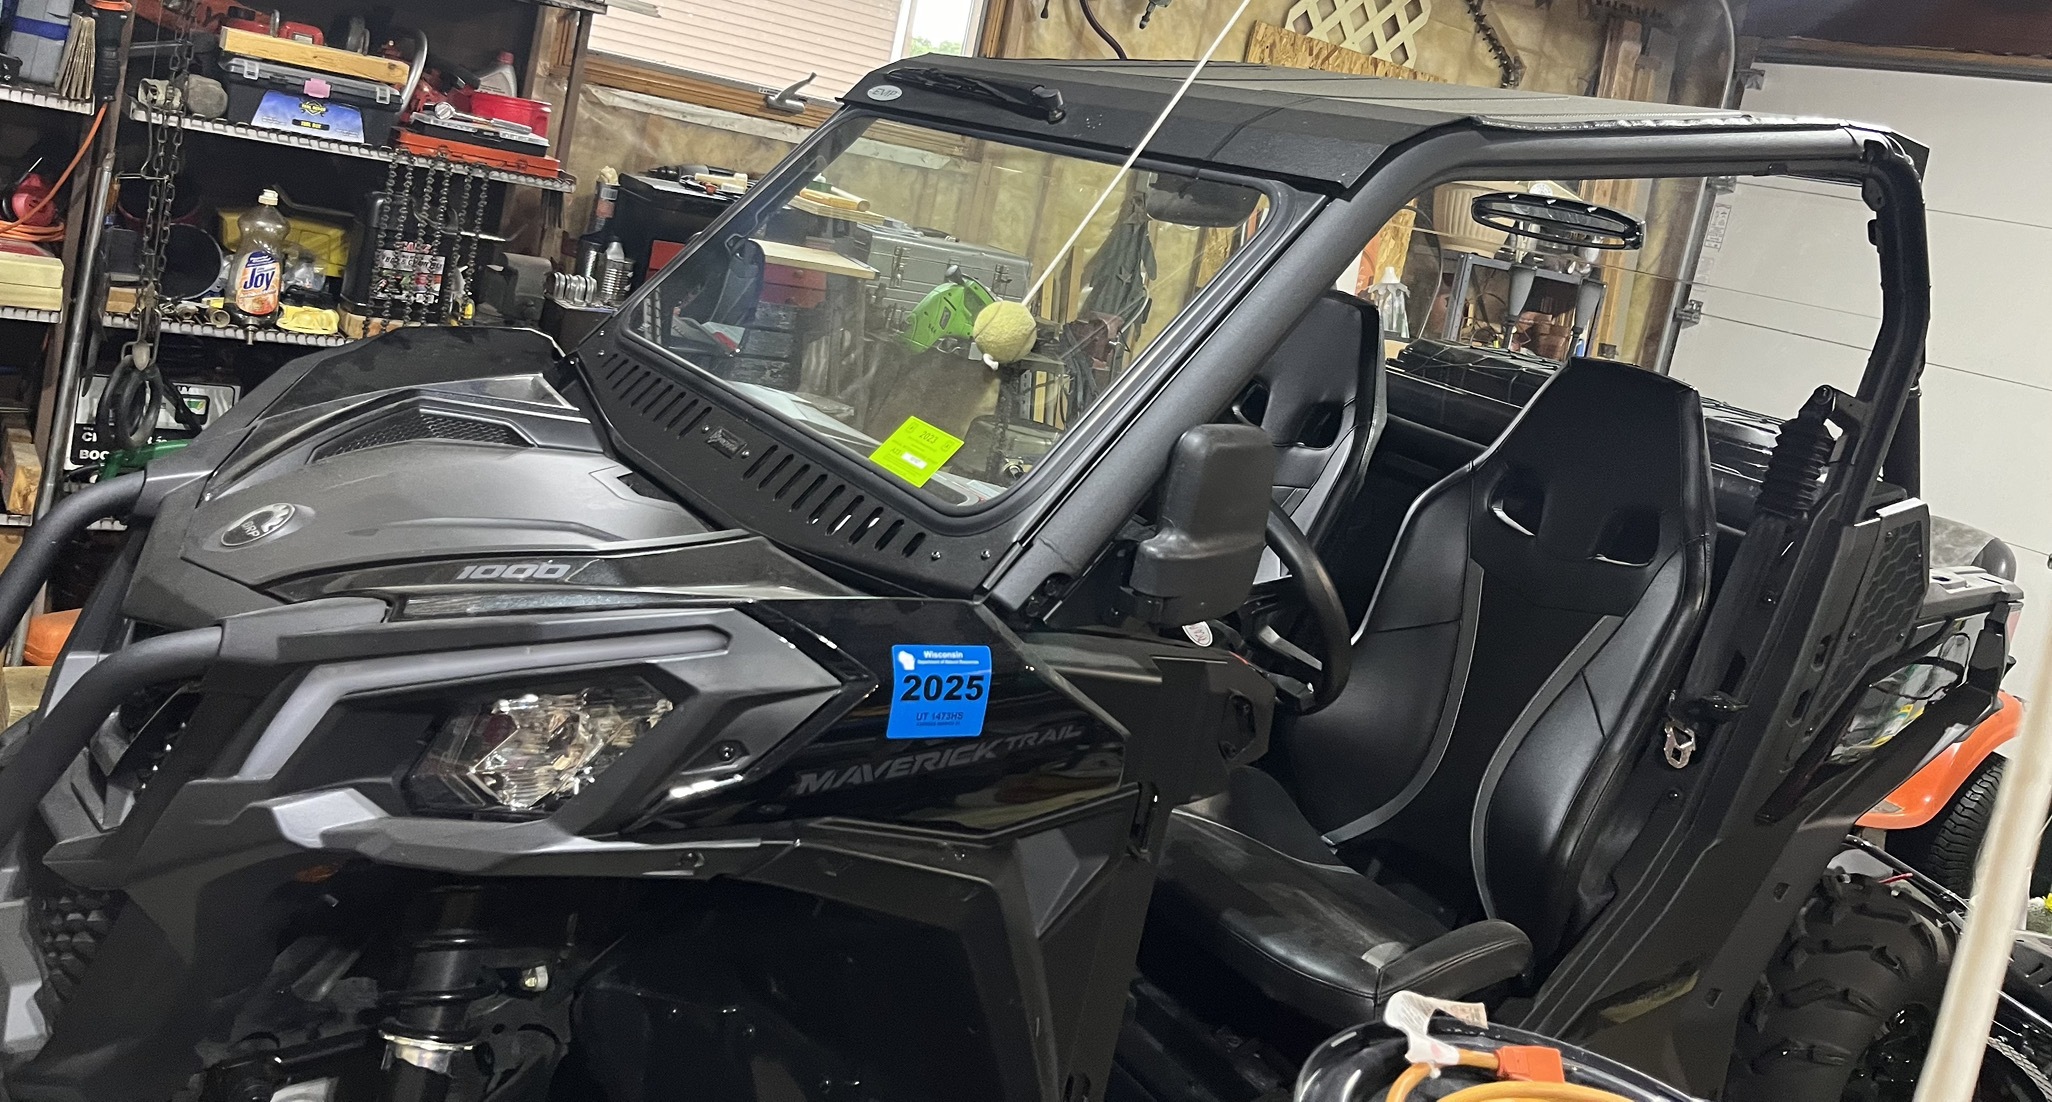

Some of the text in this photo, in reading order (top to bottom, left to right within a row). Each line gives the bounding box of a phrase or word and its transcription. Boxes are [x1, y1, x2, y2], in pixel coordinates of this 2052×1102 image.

[243, 268, 276, 291] Joy
[241, 520, 260, 537] BRP
[456, 564, 571, 579] 1000
[923, 650, 964, 659] Wisconsin
[900, 674, 985, 701] 2025
[916, 712, 929, 721] UT
[795, 723, 1084, 795] MAVERICK TRAIL
